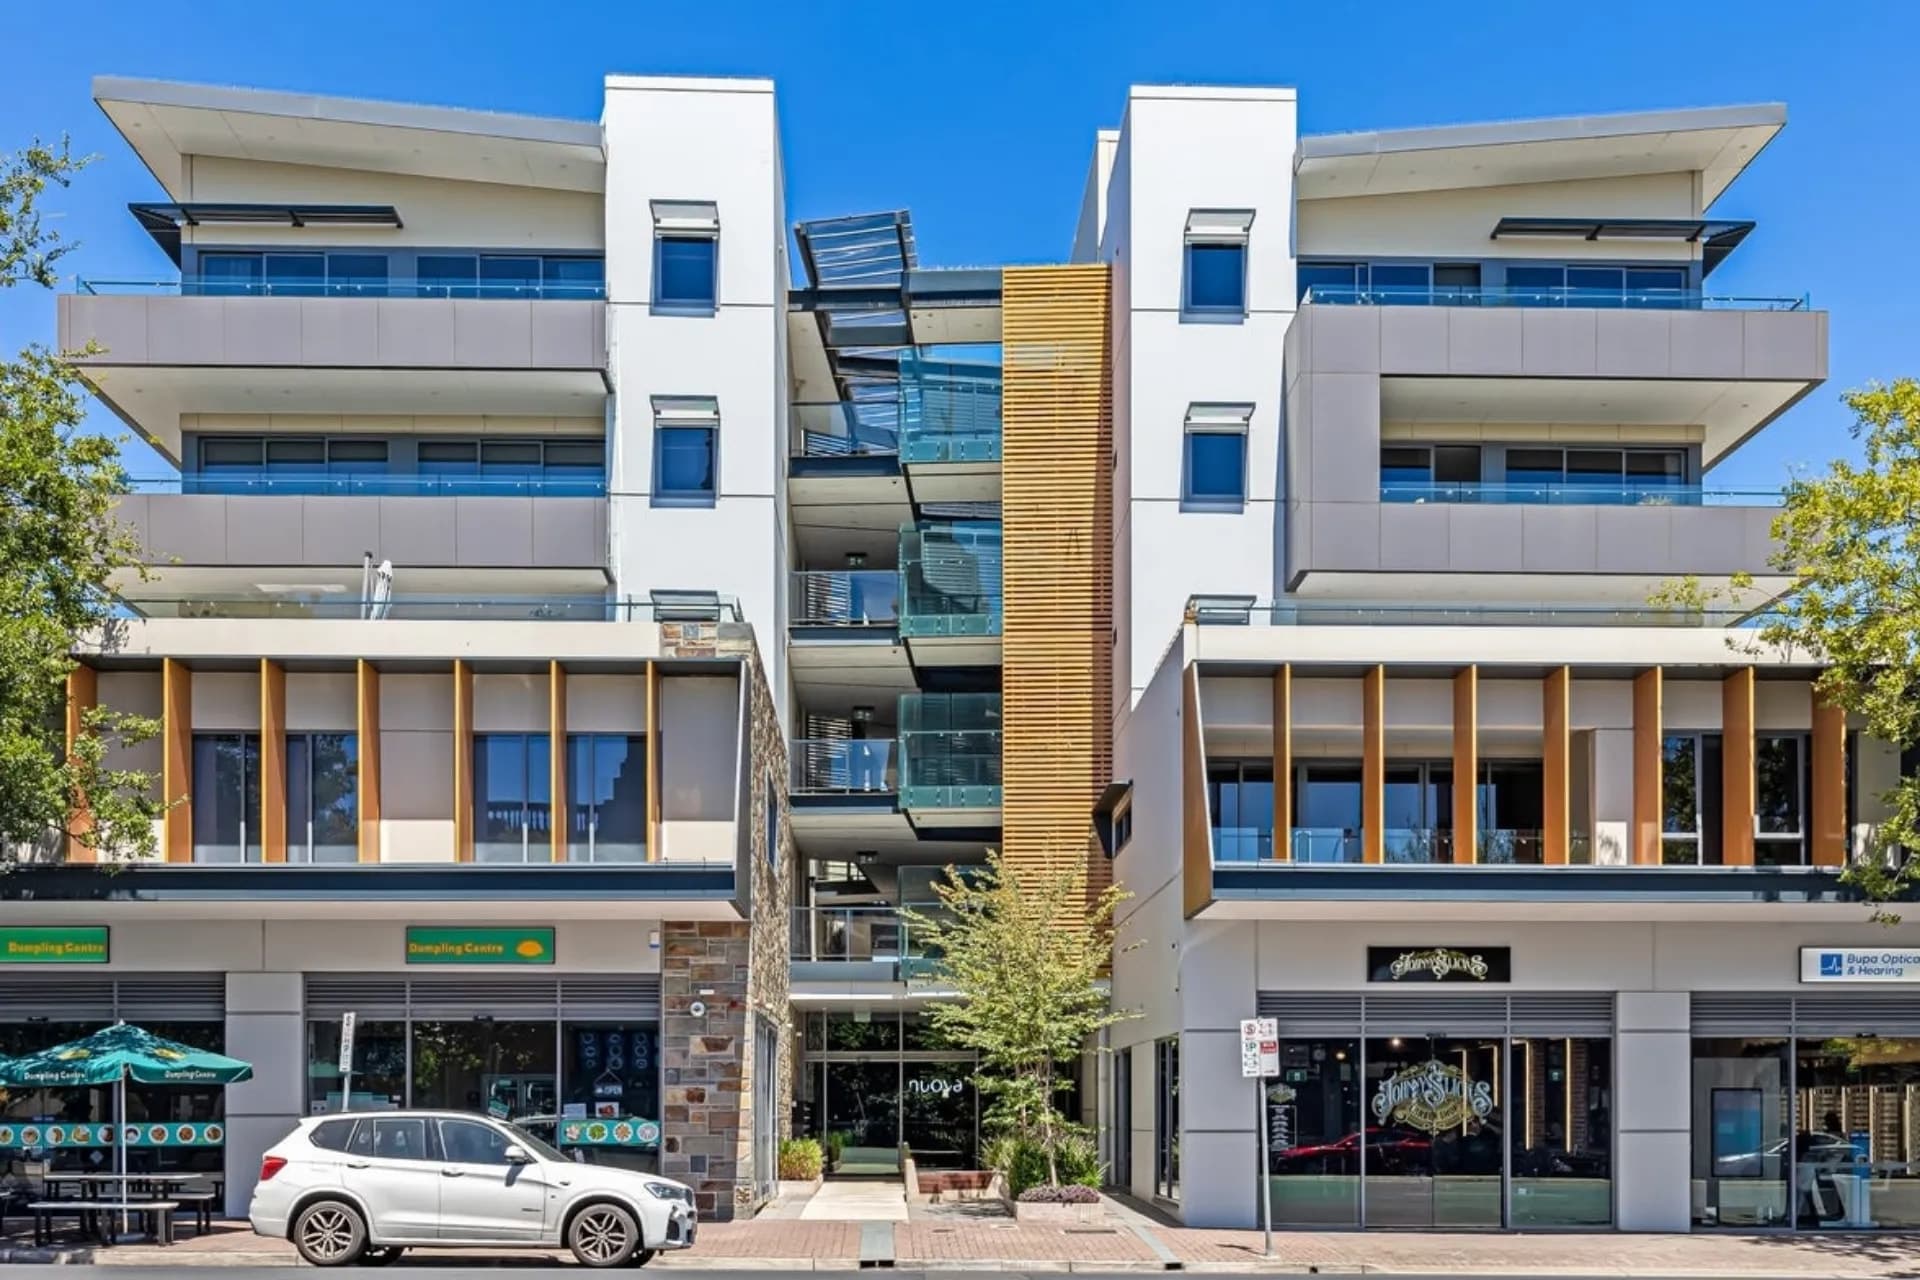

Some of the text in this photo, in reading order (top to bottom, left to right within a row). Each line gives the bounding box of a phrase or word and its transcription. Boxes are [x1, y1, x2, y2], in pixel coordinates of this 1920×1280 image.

[8, 941, 104, 955] Dumpling Centre
[408, 943, 504, 955] Dumpling Centre
[1847, 953, 1878, 965] Bupa
[1847, 966, 1903, 976] & Hearing
[24, 1071, 59, 1081] Dumpling
